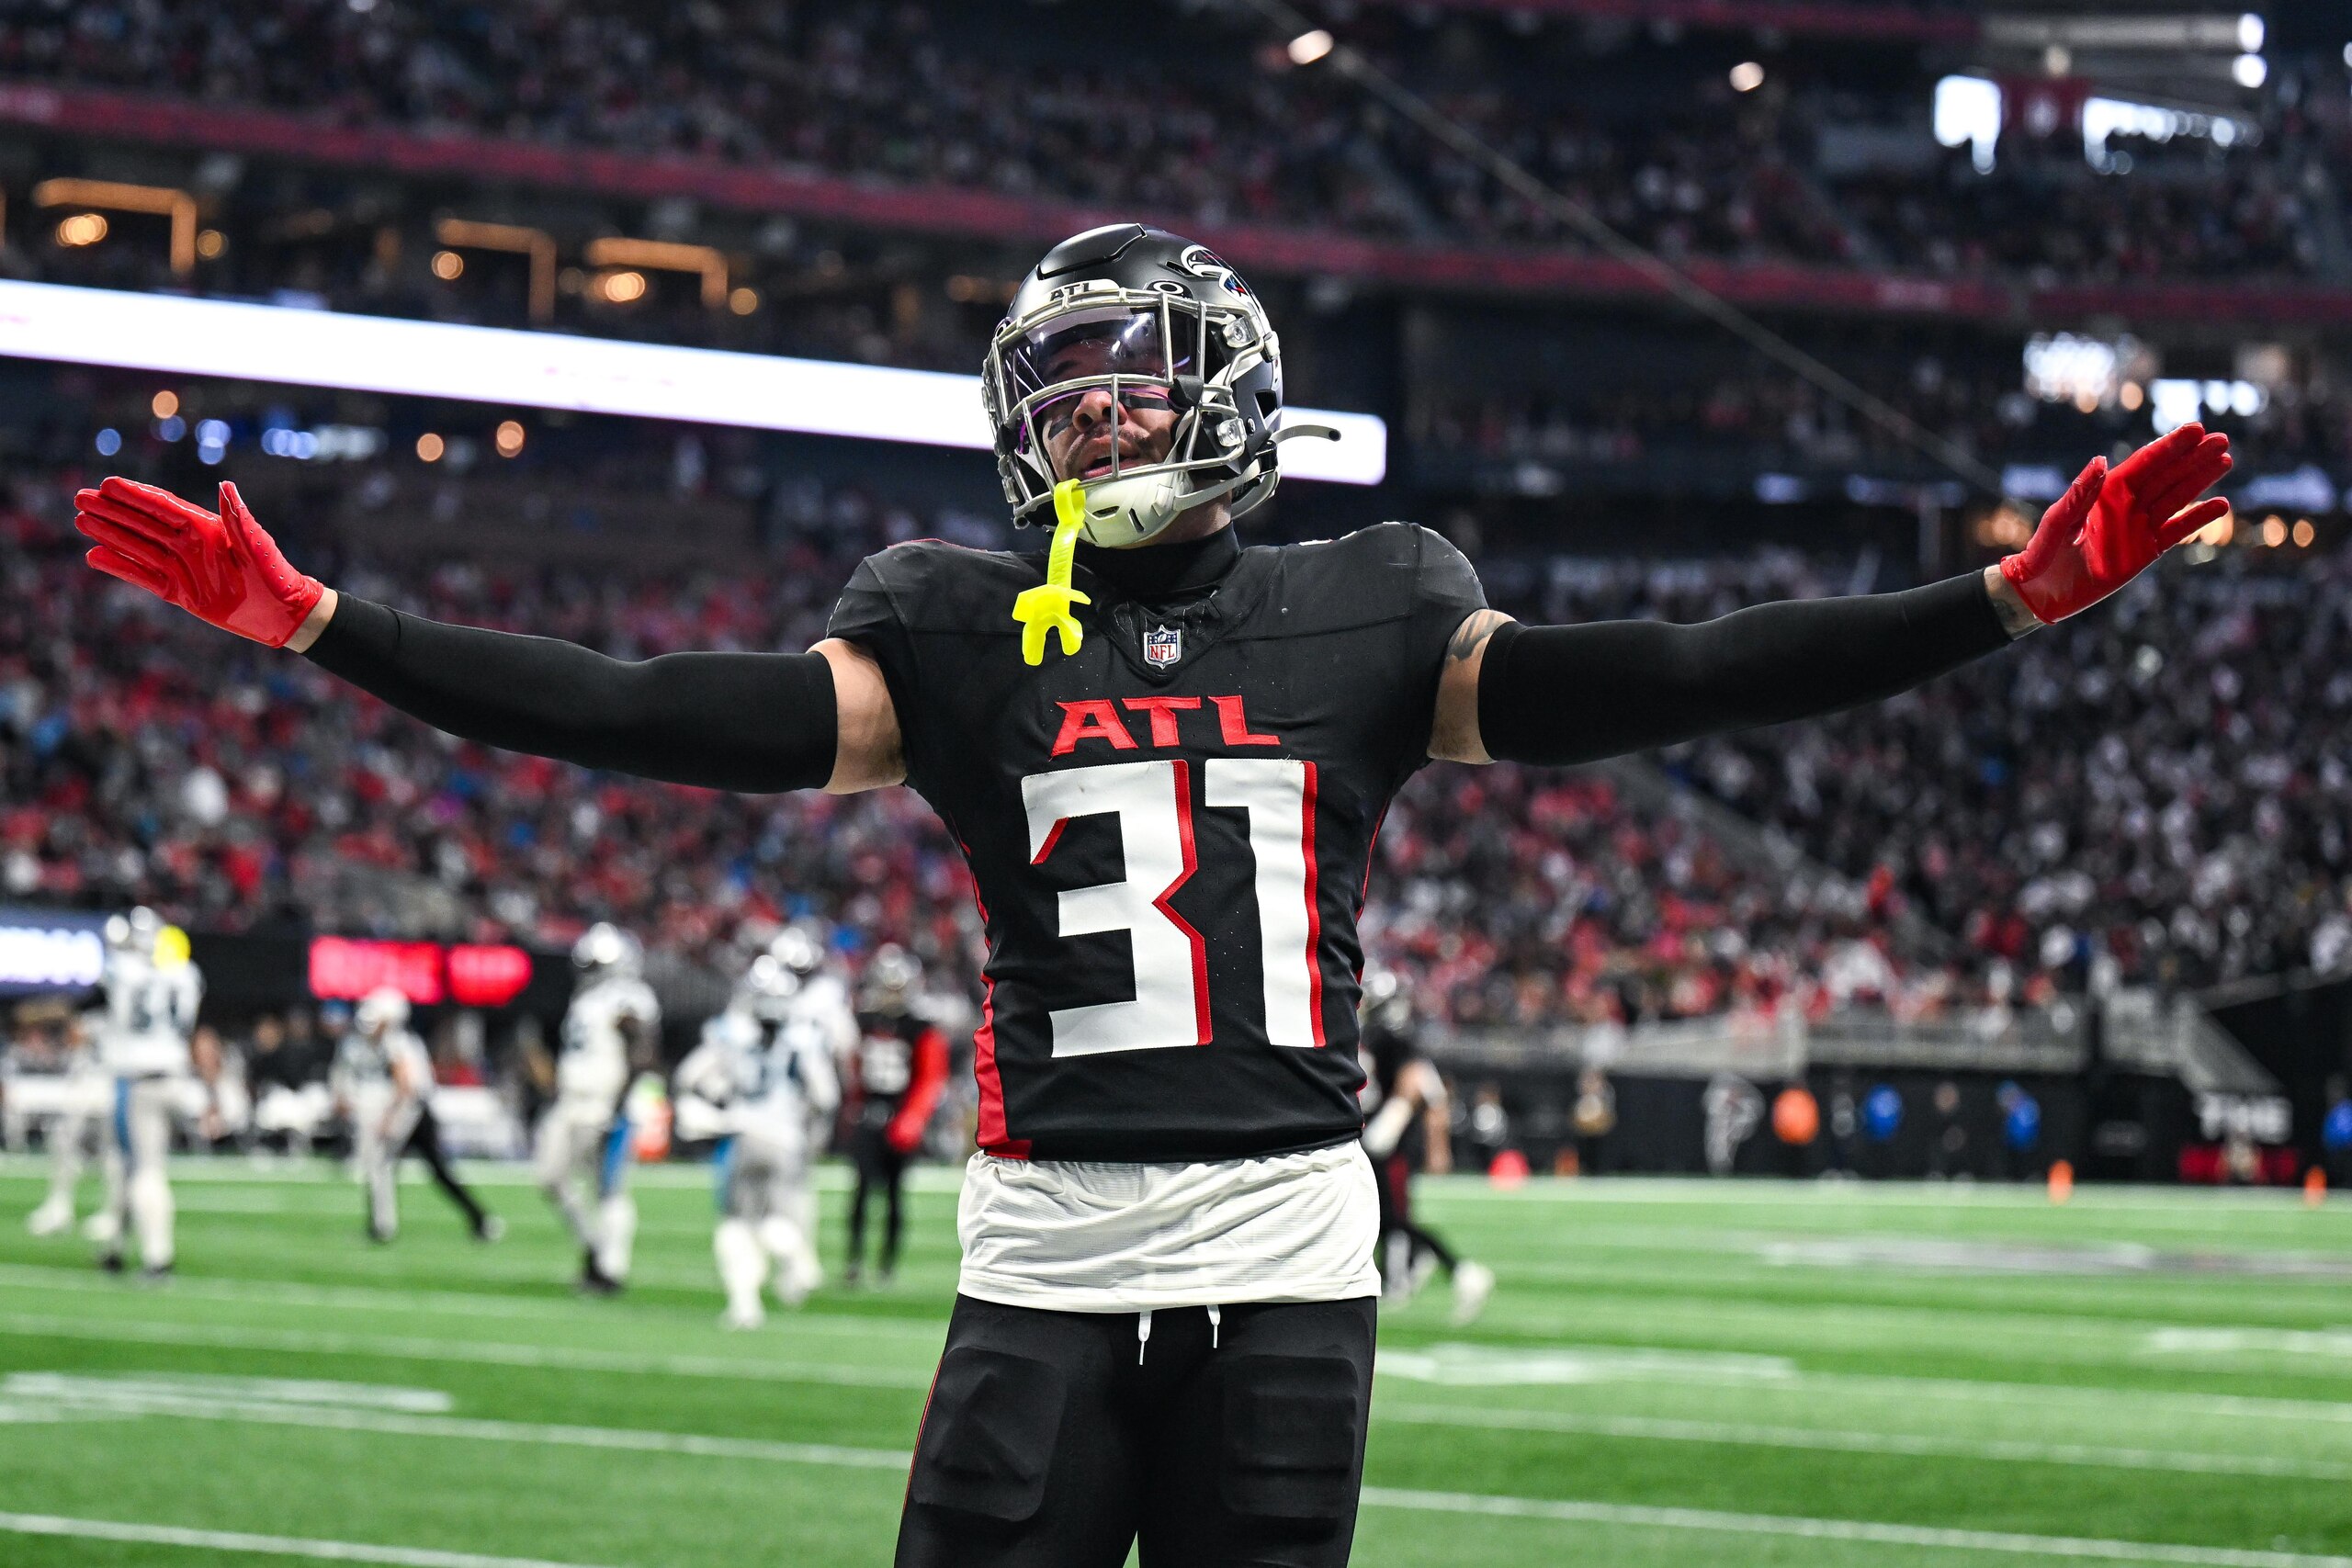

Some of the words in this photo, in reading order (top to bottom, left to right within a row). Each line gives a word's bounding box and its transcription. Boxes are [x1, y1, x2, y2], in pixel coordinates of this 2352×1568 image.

[1149, 644, 1176, 660] NFL
[1049, 694, 1281, 761] ATL
[1022, 758, 1325, 1057] 31
